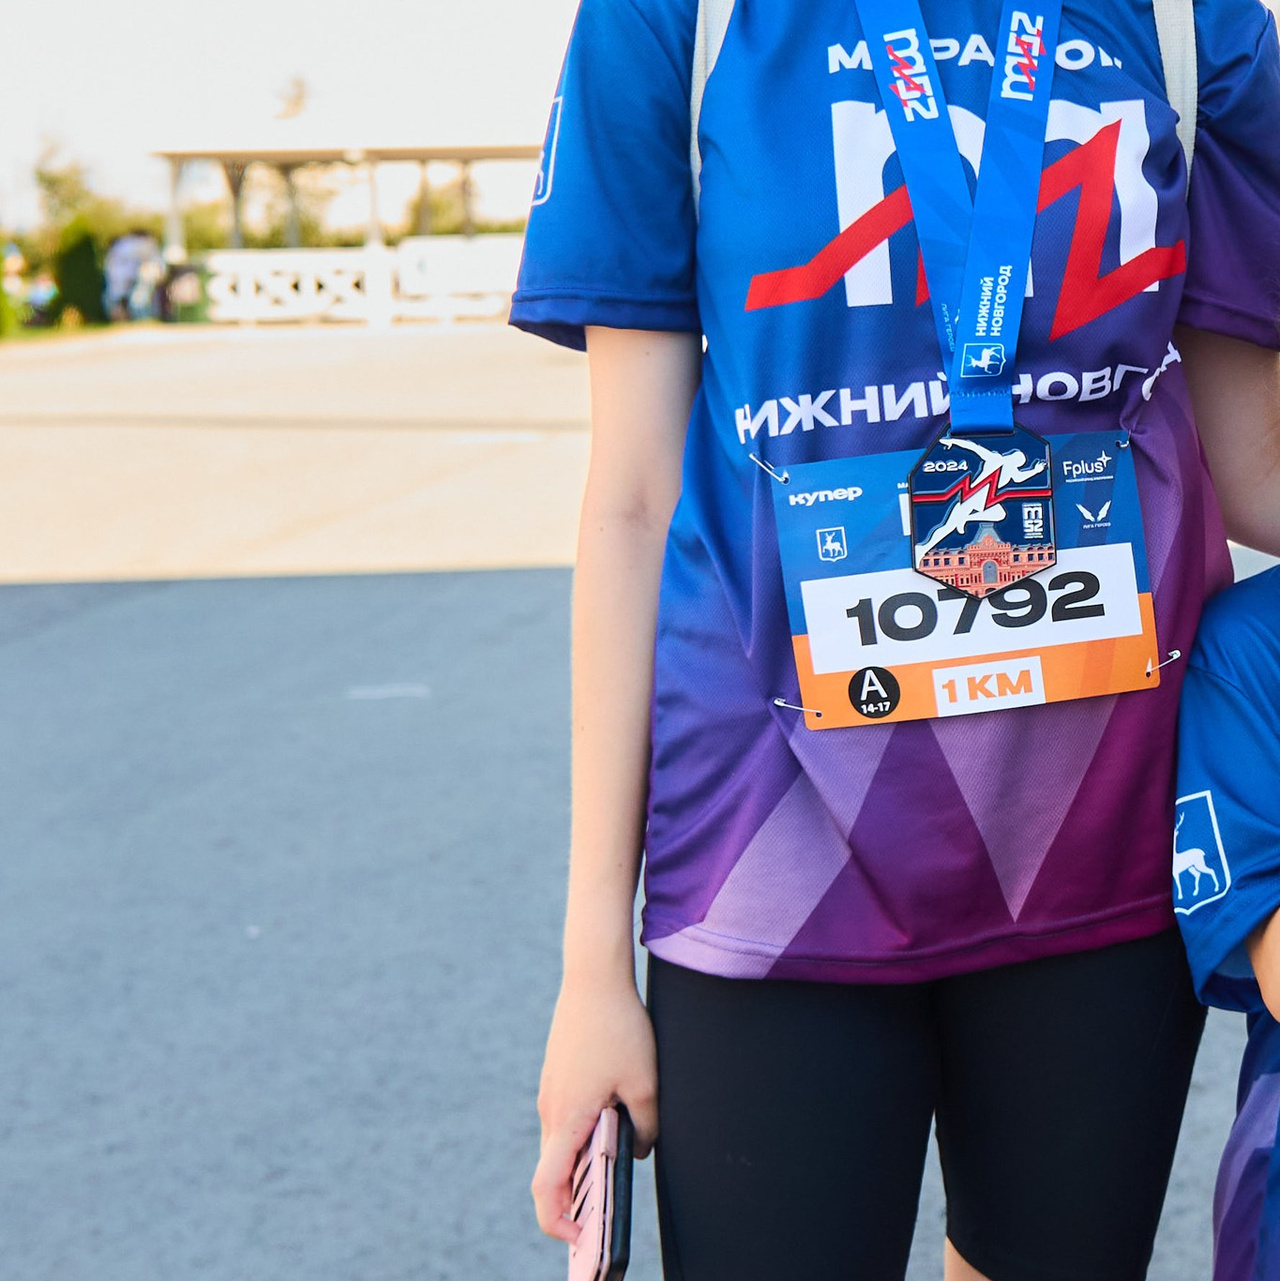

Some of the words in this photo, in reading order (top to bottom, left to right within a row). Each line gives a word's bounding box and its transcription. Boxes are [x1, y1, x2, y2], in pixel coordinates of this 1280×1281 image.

[975, 276, 994, 336] НИЖНИЙ
[990, 265, 1013, 337] НОВГОРОД
[923, 460, 968, 473] 2024
[789, 486, 863, 507] купер
[846, 571, 1106, 646] 10792
[860, 700, 891, 714] 14-17
